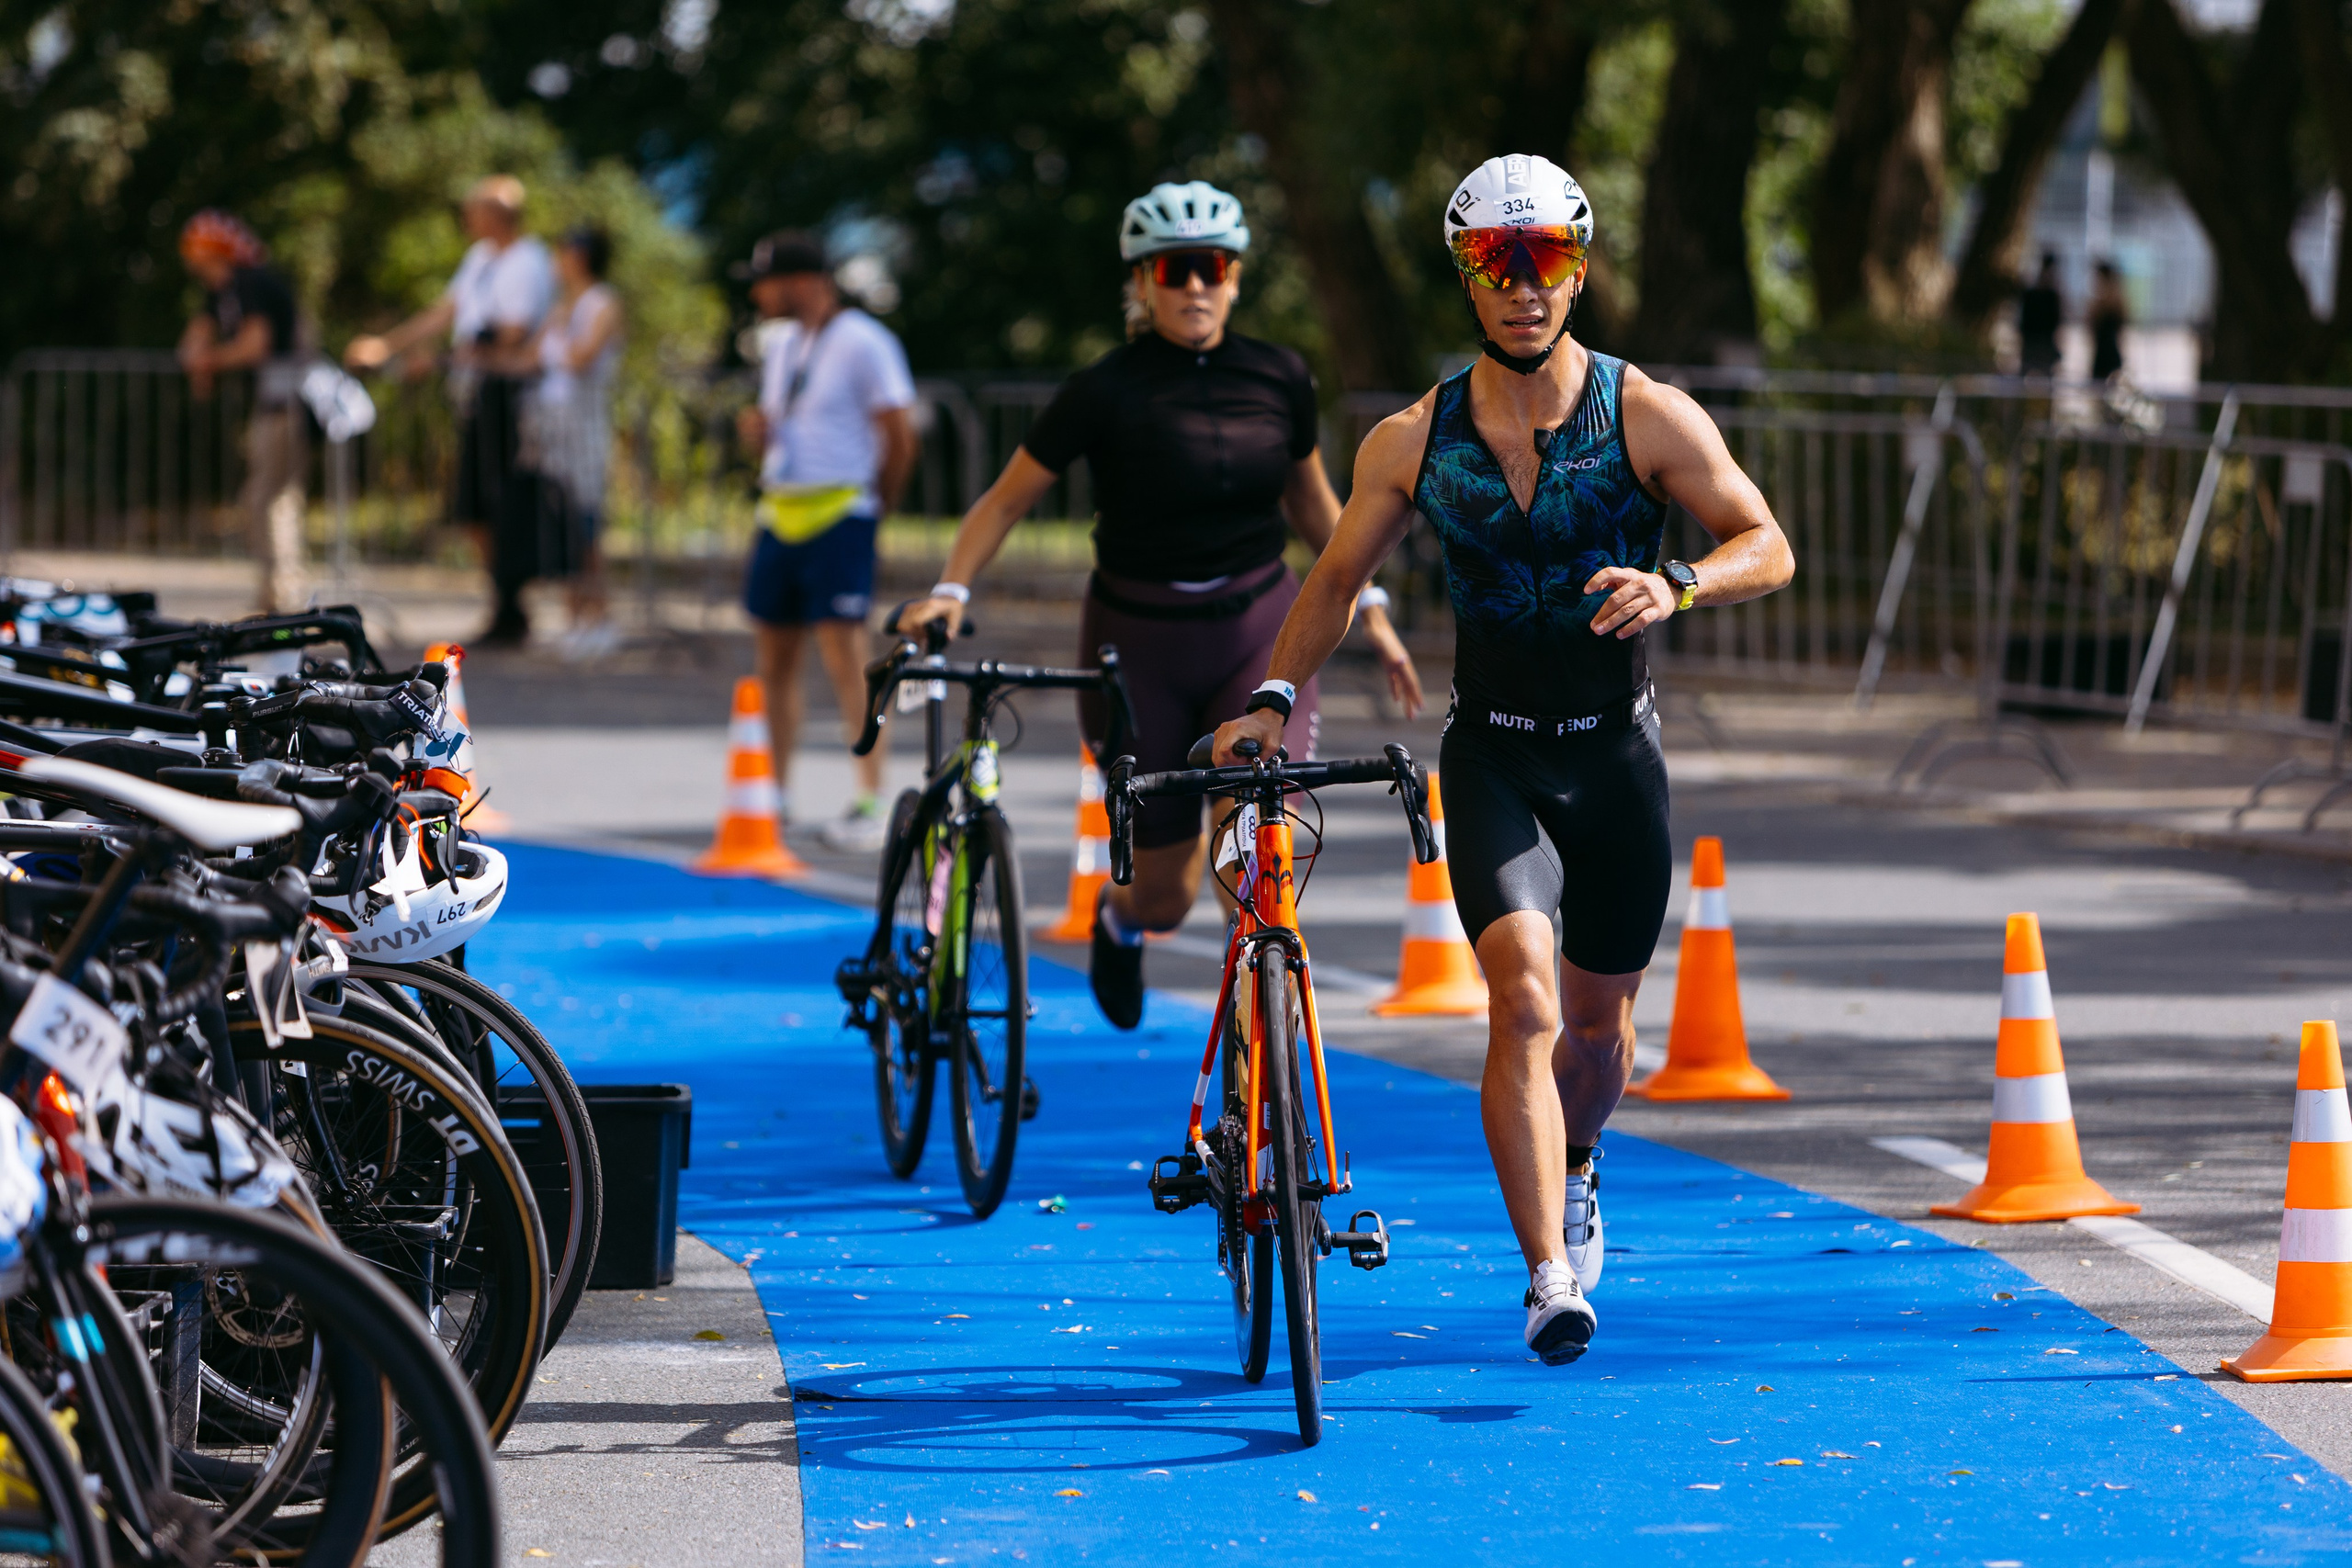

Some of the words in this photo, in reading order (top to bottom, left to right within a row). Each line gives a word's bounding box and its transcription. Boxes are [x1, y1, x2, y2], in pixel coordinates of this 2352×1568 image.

[1502, 197, 1535, 215] 334
[252, 705, 283, 718] PURSUIT
[436, 901, 467, 925] 297
[339, 919, 433, 953] KASK
[43, 1004, 106, 1056] 291
[341, 1050, 435, 1111] SWISS
[427, 1112, 480, 1156] DT
